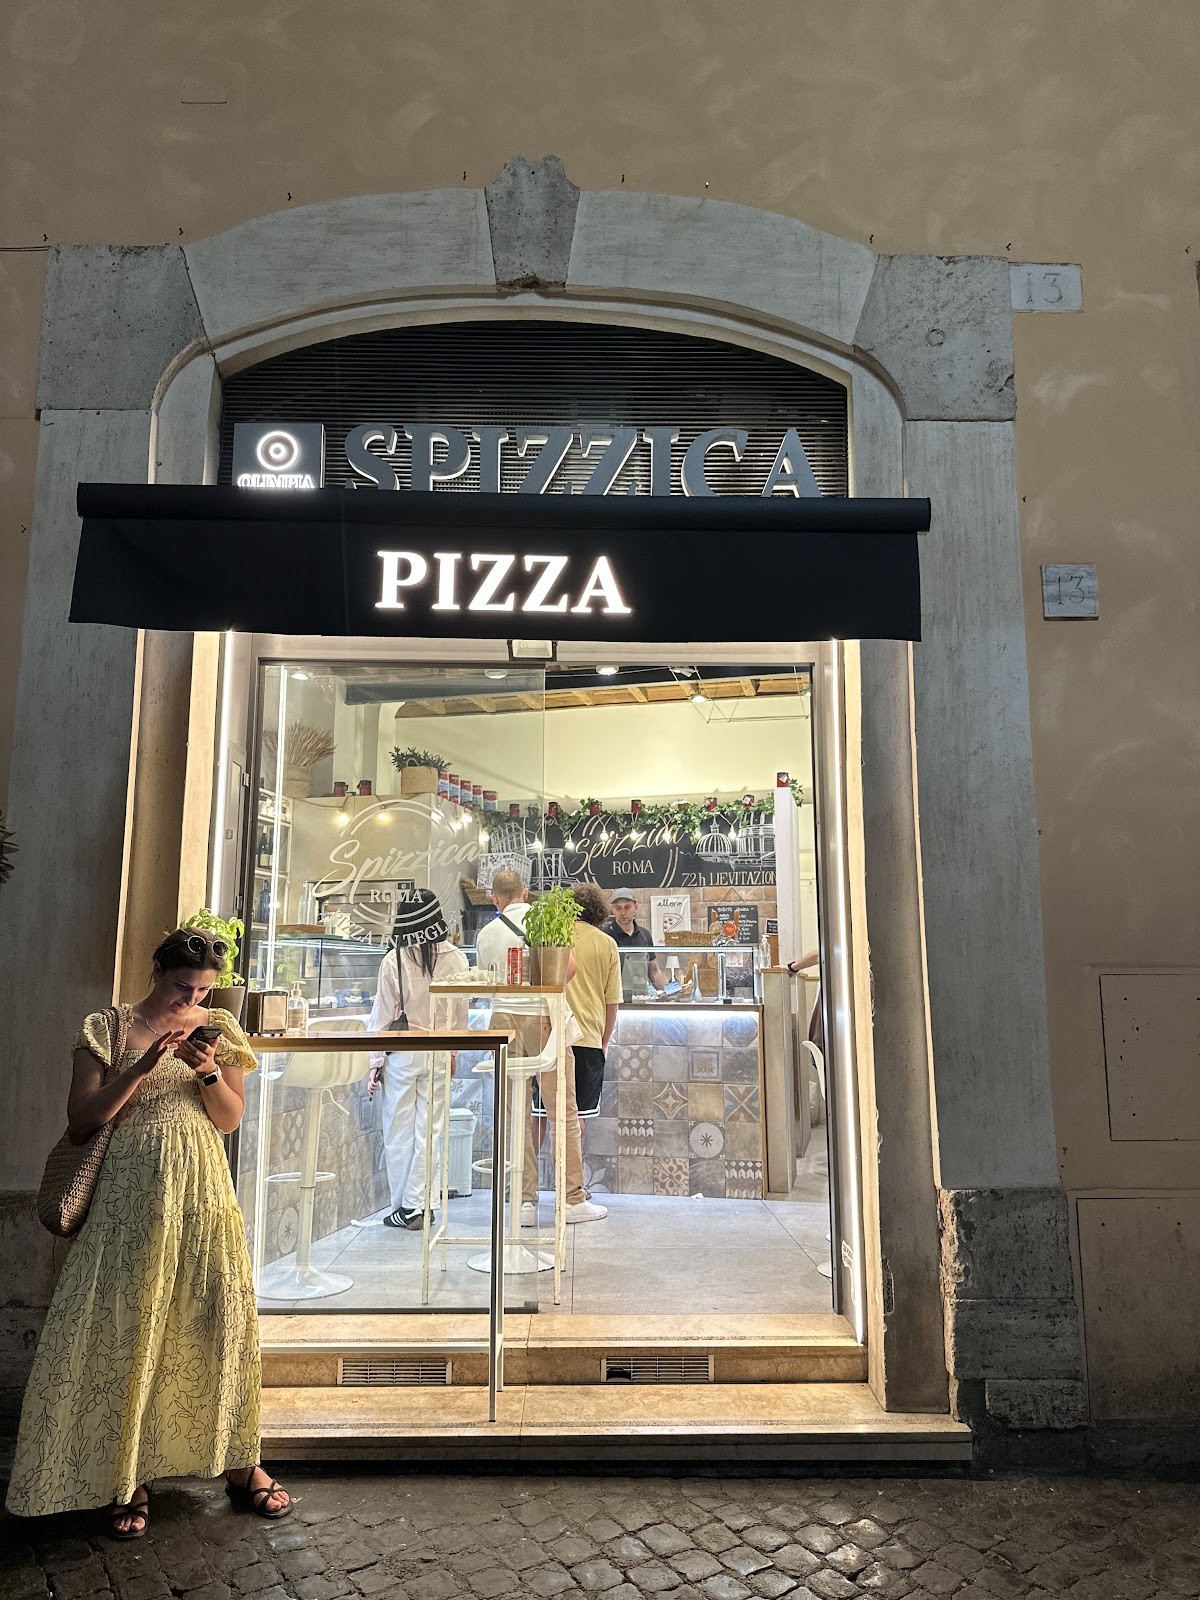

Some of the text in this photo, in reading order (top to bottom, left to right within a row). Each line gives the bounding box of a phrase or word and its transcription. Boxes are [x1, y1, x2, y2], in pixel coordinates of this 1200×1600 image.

[1024, 272, 1064, 304] 13
[344, 423, 823, 498] SPIZZICA
[236, 473, 316, 489] OLIMPIA
[374, 549, 632, 614] PIZZA
[1055, 575, 1086, 606] 13
[312, 839, 482, 905] Spizzica
[612, 859, 655, 876] ROMA
[369, 888, 424, 903] ROMA
[657, 898, 683, 908] allora
[379, 933, 399, 949] IN
